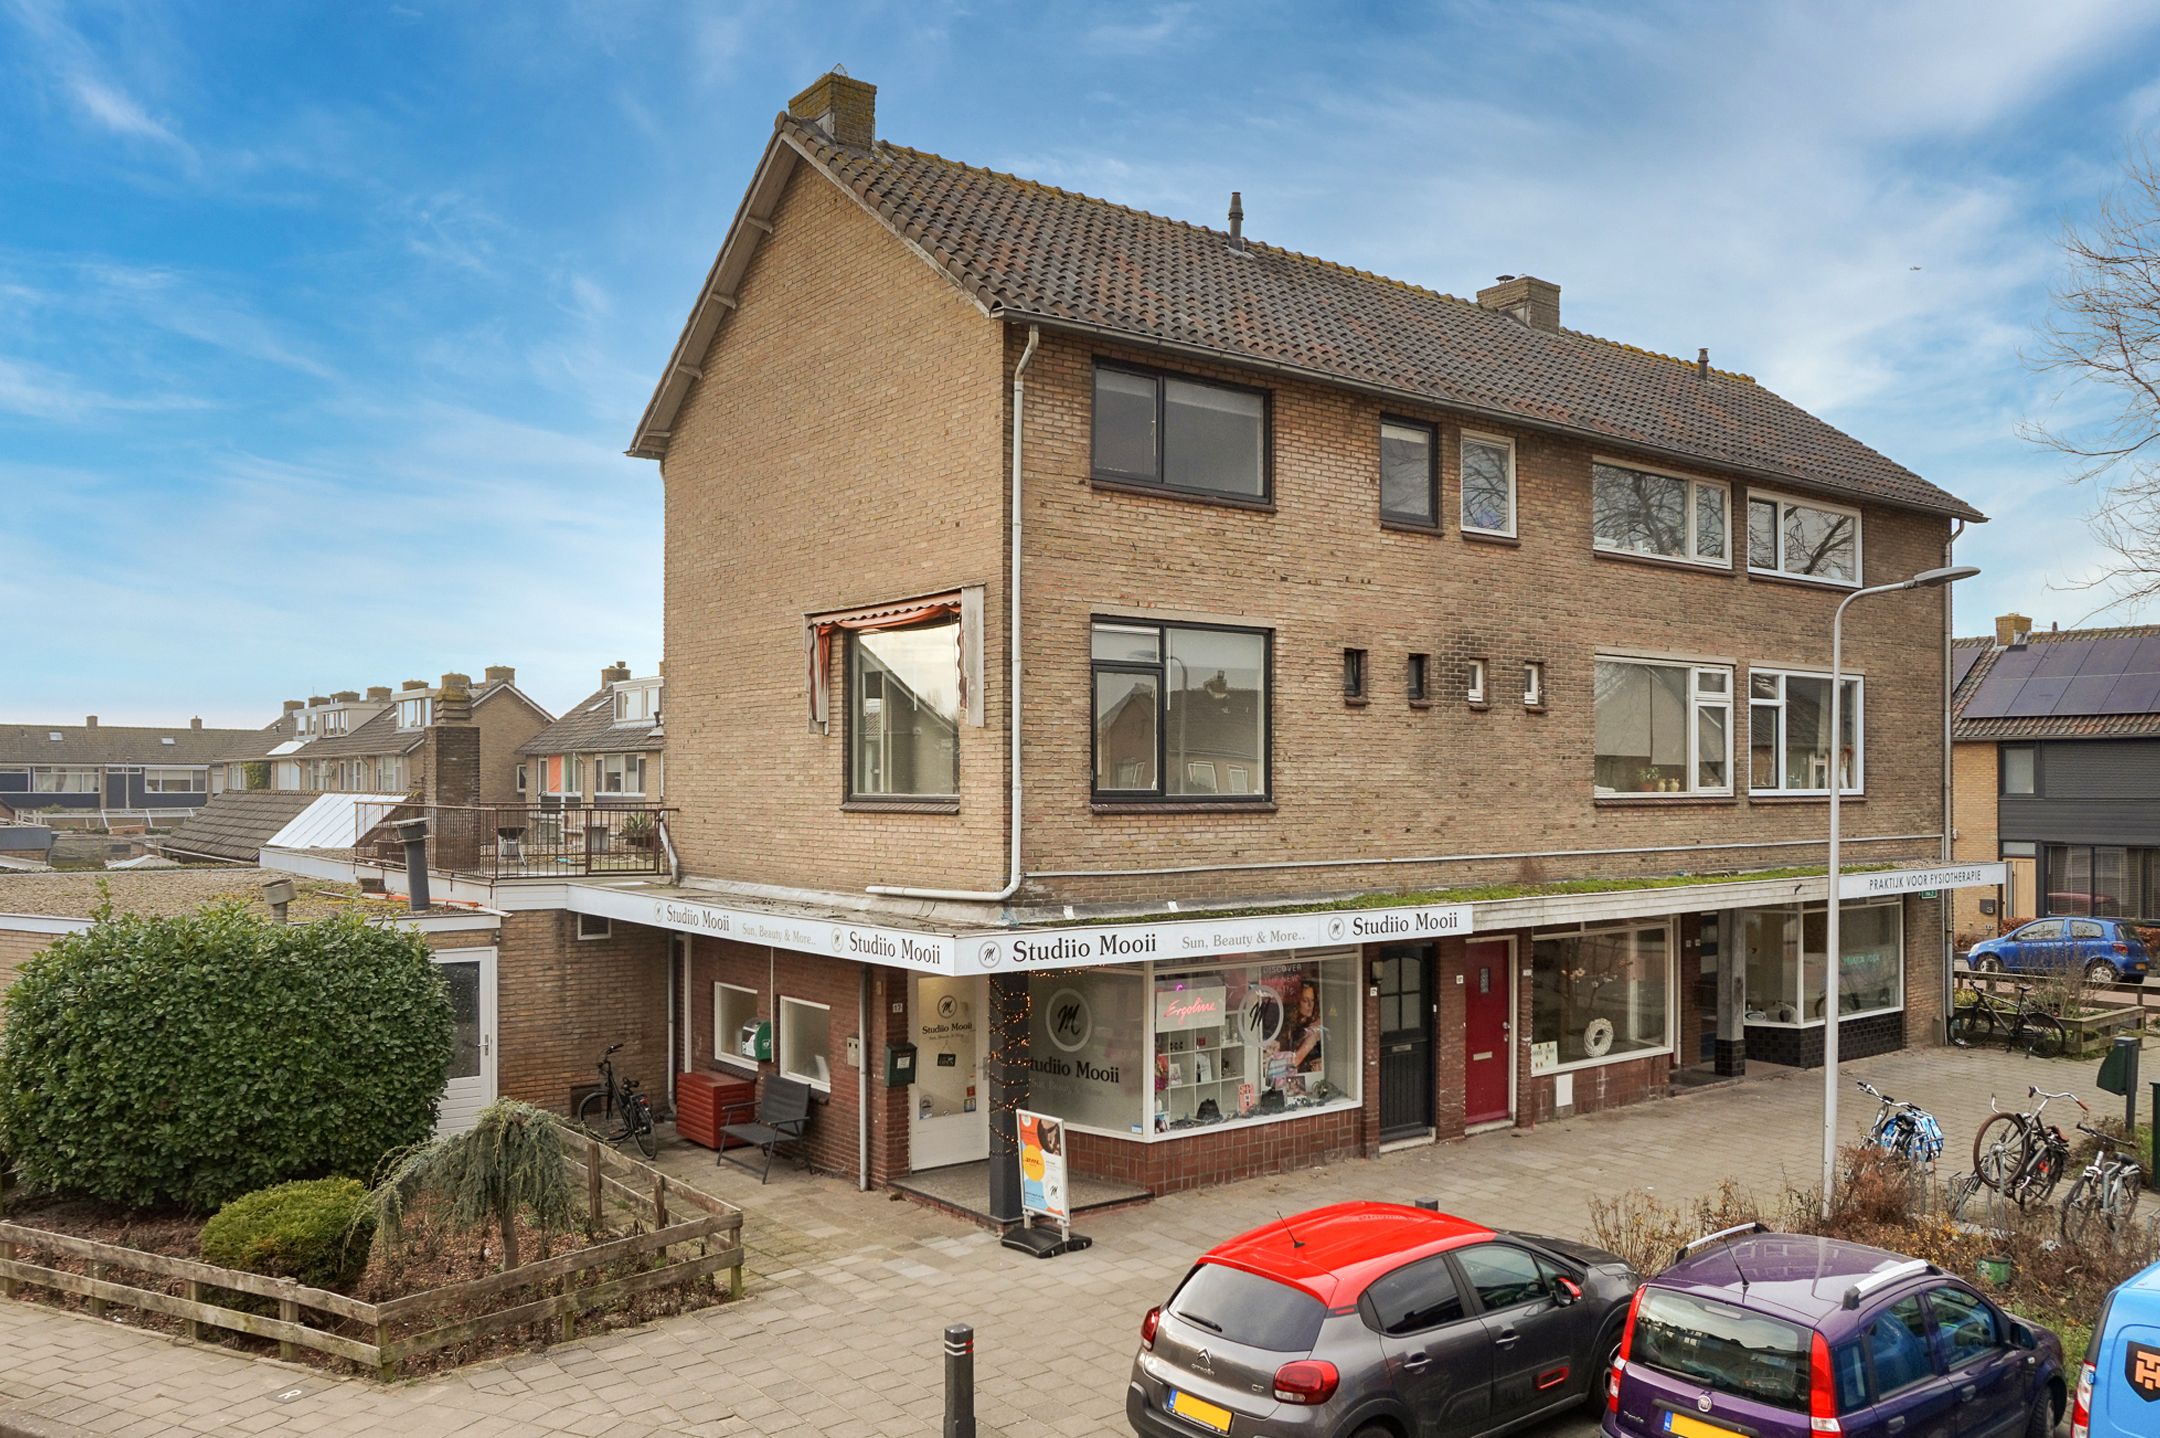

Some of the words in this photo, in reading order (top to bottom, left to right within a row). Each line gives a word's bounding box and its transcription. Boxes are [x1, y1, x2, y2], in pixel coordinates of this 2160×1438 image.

[1869, 879, 1904, 891] PRAKTIJK
[1906, 875, 1928, 887] VOOR
[1930, 869, 1982, 885] FYSIOTHERAPIE
[666, 904, 699, 927] Studiio
[702, 909, 730, 932] Mooii
[1352, 914, 1409, 936] Studiio
[1416, 912, 1458, 931] Mooii
[742, 923, 757, 935] Sun,
[759, 925, 782, 943] Beauty
[784, 929, 790, 942] &
[1182, 936, 1209, 949] Sun,
[1213, 934, 1253, 947] Beauty
[1256, 931, 1266, 943] &
[849, 931, 896, 958] Studiio
[901, 938, 940, 965] Mooii
[1012, 938, 1091, 962] Studiio
[1099, 933, 1157, 956] Mooii
[922, 1025, 949, 1035] Studiio
[1029, 1056, 1071, 1077] tudiio
[1076, 1060, 1120, 1083] Mooii
